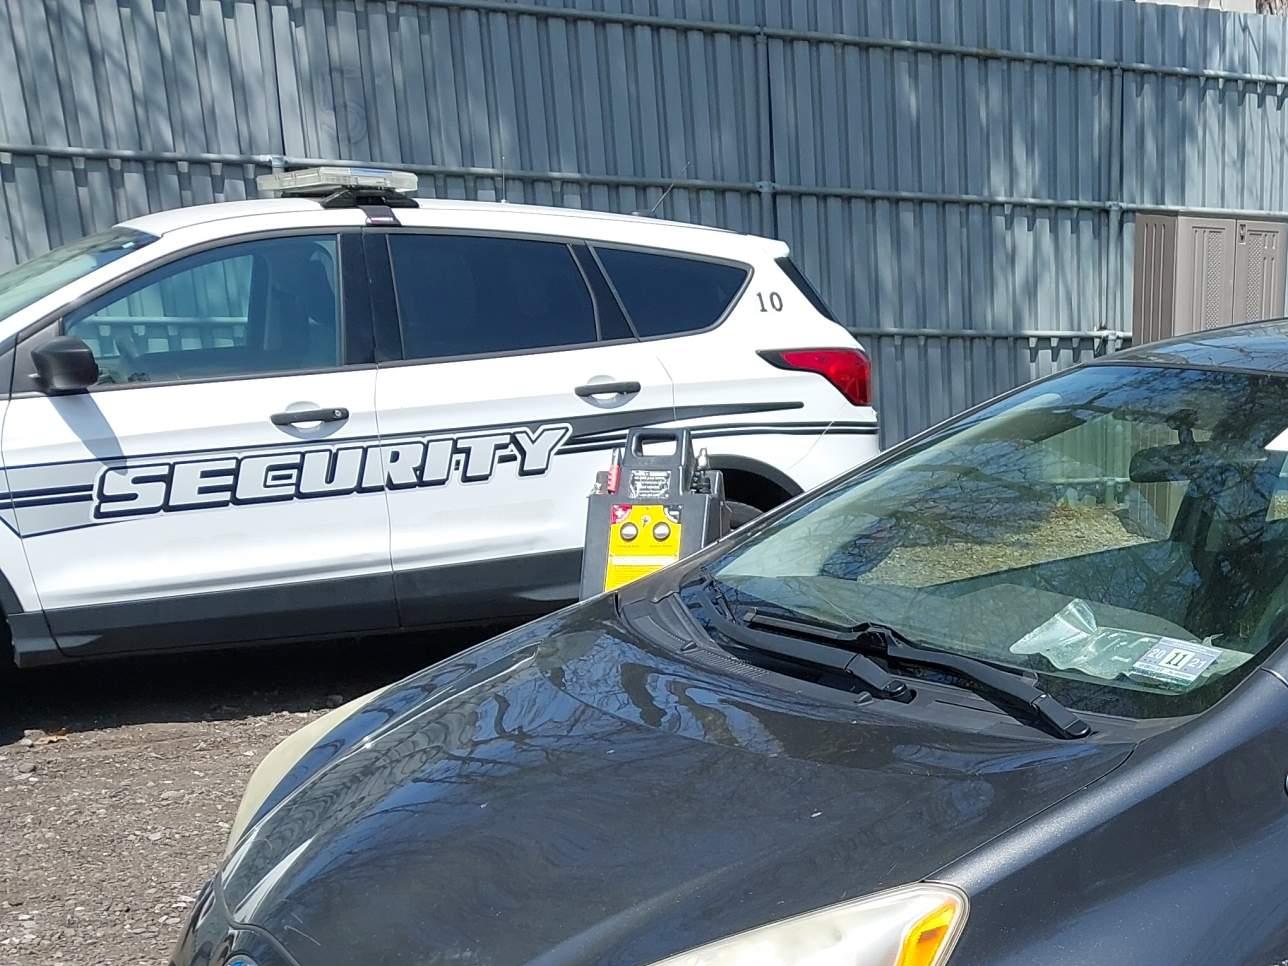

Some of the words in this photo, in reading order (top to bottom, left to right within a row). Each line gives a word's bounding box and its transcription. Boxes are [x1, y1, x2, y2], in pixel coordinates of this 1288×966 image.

[755, 291, 784, 313] 10
[93, 424, 571, 519] SECURITY
[1147, 647, 1167, 659] 20
[1165, 651, 1189, 667] 11
